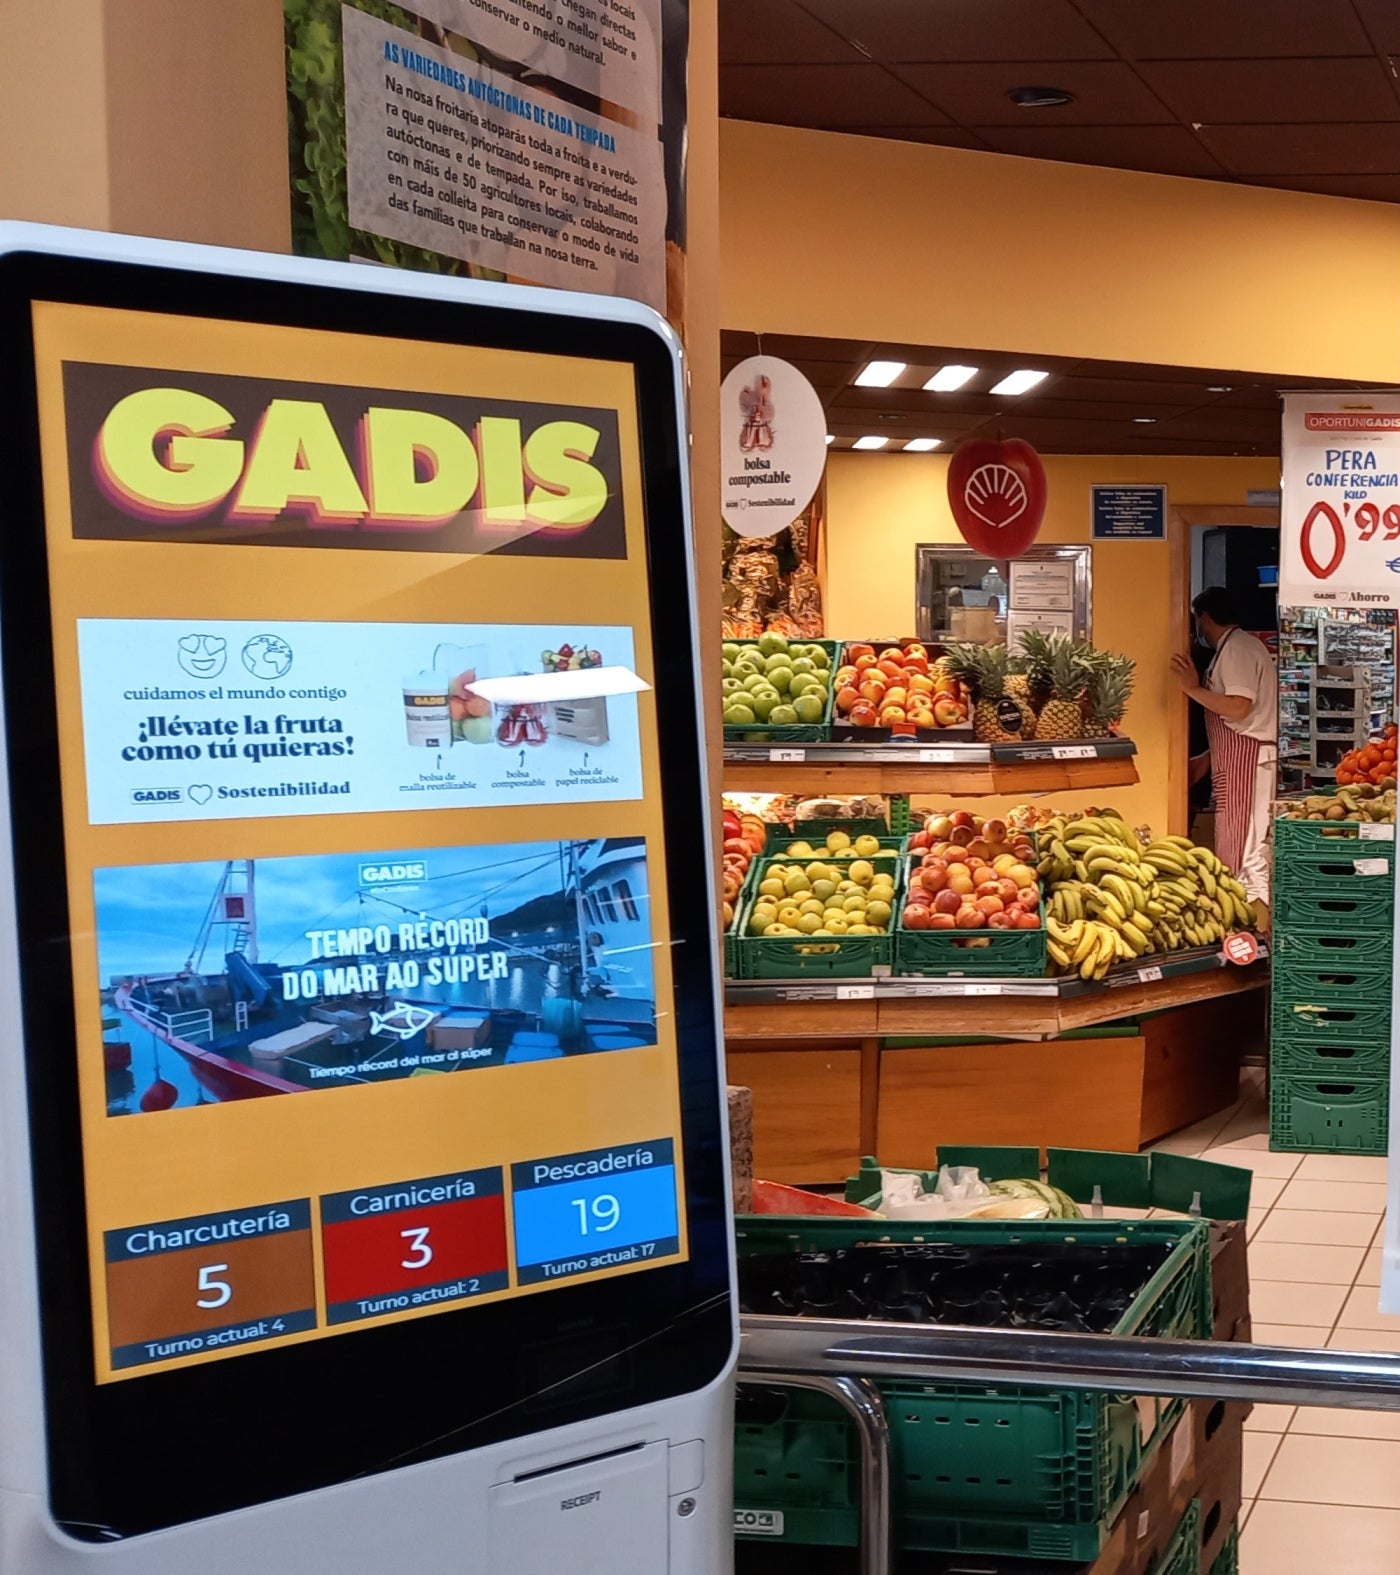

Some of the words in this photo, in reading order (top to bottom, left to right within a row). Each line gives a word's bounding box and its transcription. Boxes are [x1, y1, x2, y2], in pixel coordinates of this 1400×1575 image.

[384, 41, 399, 64] AS
[402, 48, 466, 92] VARIEDADES
[468, 77, 531, 121] AUTÓCTONAS
[533, 105, 546, 126] DE
[548, 112, 573, 137] CADA
[575, 122, 616, 153] TEMPADA
[385, 75, 403, 95] Na
[405, 87, 433, 107] nosa
[436, 95, 479, 126] froitaria
[481, 117, 526, 145] atoparás
[528, 135, 553, 155] toda
[555, 148, 561, 158] a
[562, 147, 590, 169] froita
[593, 162, 599, 171] e
[600, 165, 607, 175] a
[386, 103, 398, 116] ra
[402, 110, 424, 125] que
[428, 119, 469, 145] queres,
[471, 136, 530, 167] priorizando
[533, 160, 571, 182] sempre
[574, 175, 585, 186] as
[587, 179, 638, 205] variedades
[388, 193, 409, 212] das
[412, 200, 455, 227] familias
[457, 219, 478, 234] que
[481, 224, 525, 250] traballan
[529, 243, 541, 254] na
[545, 247, 568, 262] nosa
[571, 252, 598, 271] terra.
[93, 387, 608, 529] GADIS
[744, 457, 770, 470] bolsa
[1325, 449, 1377, 471] PERA
[728, 471, 791, 488] compostable
[1306, 473, 1399, 487] CONFERENCIA
[1344, 490, 1368, 499] KILO
[1349, 592, 1390, 602] Ahorro
[123, 687, 206, 700] cuidamos
[209, 686, 223, 699] el
[227, 686, 286, 699] mundo
[288, 686, 348, 702] contigo
[138, 715, 239, 743] ¡llévate
[244, 715, 270, 735] la
[275, 714, 344, 735] fruta
[121, 744, 202, 761] como
[207, 738, 238, 759] tú
[243, 735, 354, 764] quieras!
[134, 790, 181, 802] GADIS
[217, 782, 351, 800] Sostenibilidad
[363, 864, 424, 882] GADIS
[305, 924, 391, 959] TEMPO
[399, 911, 489, 952] RÉCORD
[282, 969, 318, 999] DO
[323, 964, 379, 996] MAR
[385, 960, 420, 990] AO
[427, 946, 509, 986] SÚPER
[309, 1065, 356, 1079] Tiempo
[357, 1059, 398, 1072] récord
[400, 1055, 419, 1066] del
[421, 1053, 445, 1064] mar
[447, 1050, 459, 1061] al
[461, 1047, 492, 1060] súper
[532, 1148, 653, 1184] Pescadería
[350, 1179, 475, 1215] Carnicería
[570, 1194, 620, 1235] 19
[126, 1210, 290, 1253] Charcutería
[400, 1226, 433, 1269] 3
[542, 1257, 588, 1276] Turno
[590, 1245, 639, 1267] actual:
[640, 1242, 656, 1256] 17
[196, 1264, 232, 1309] 5
[357, 1295, 409, 1315] Turno
[412, 1282, 466, 1304] actual:
[468, 1278, 481, 1292] 2
[144, 1338, 204, 1357] Turno
[206, 1322, 269, 1344] actual:
[271, 1318, 286, 1332] 4
[561, 1490, 602, 1511] RECEIPT
